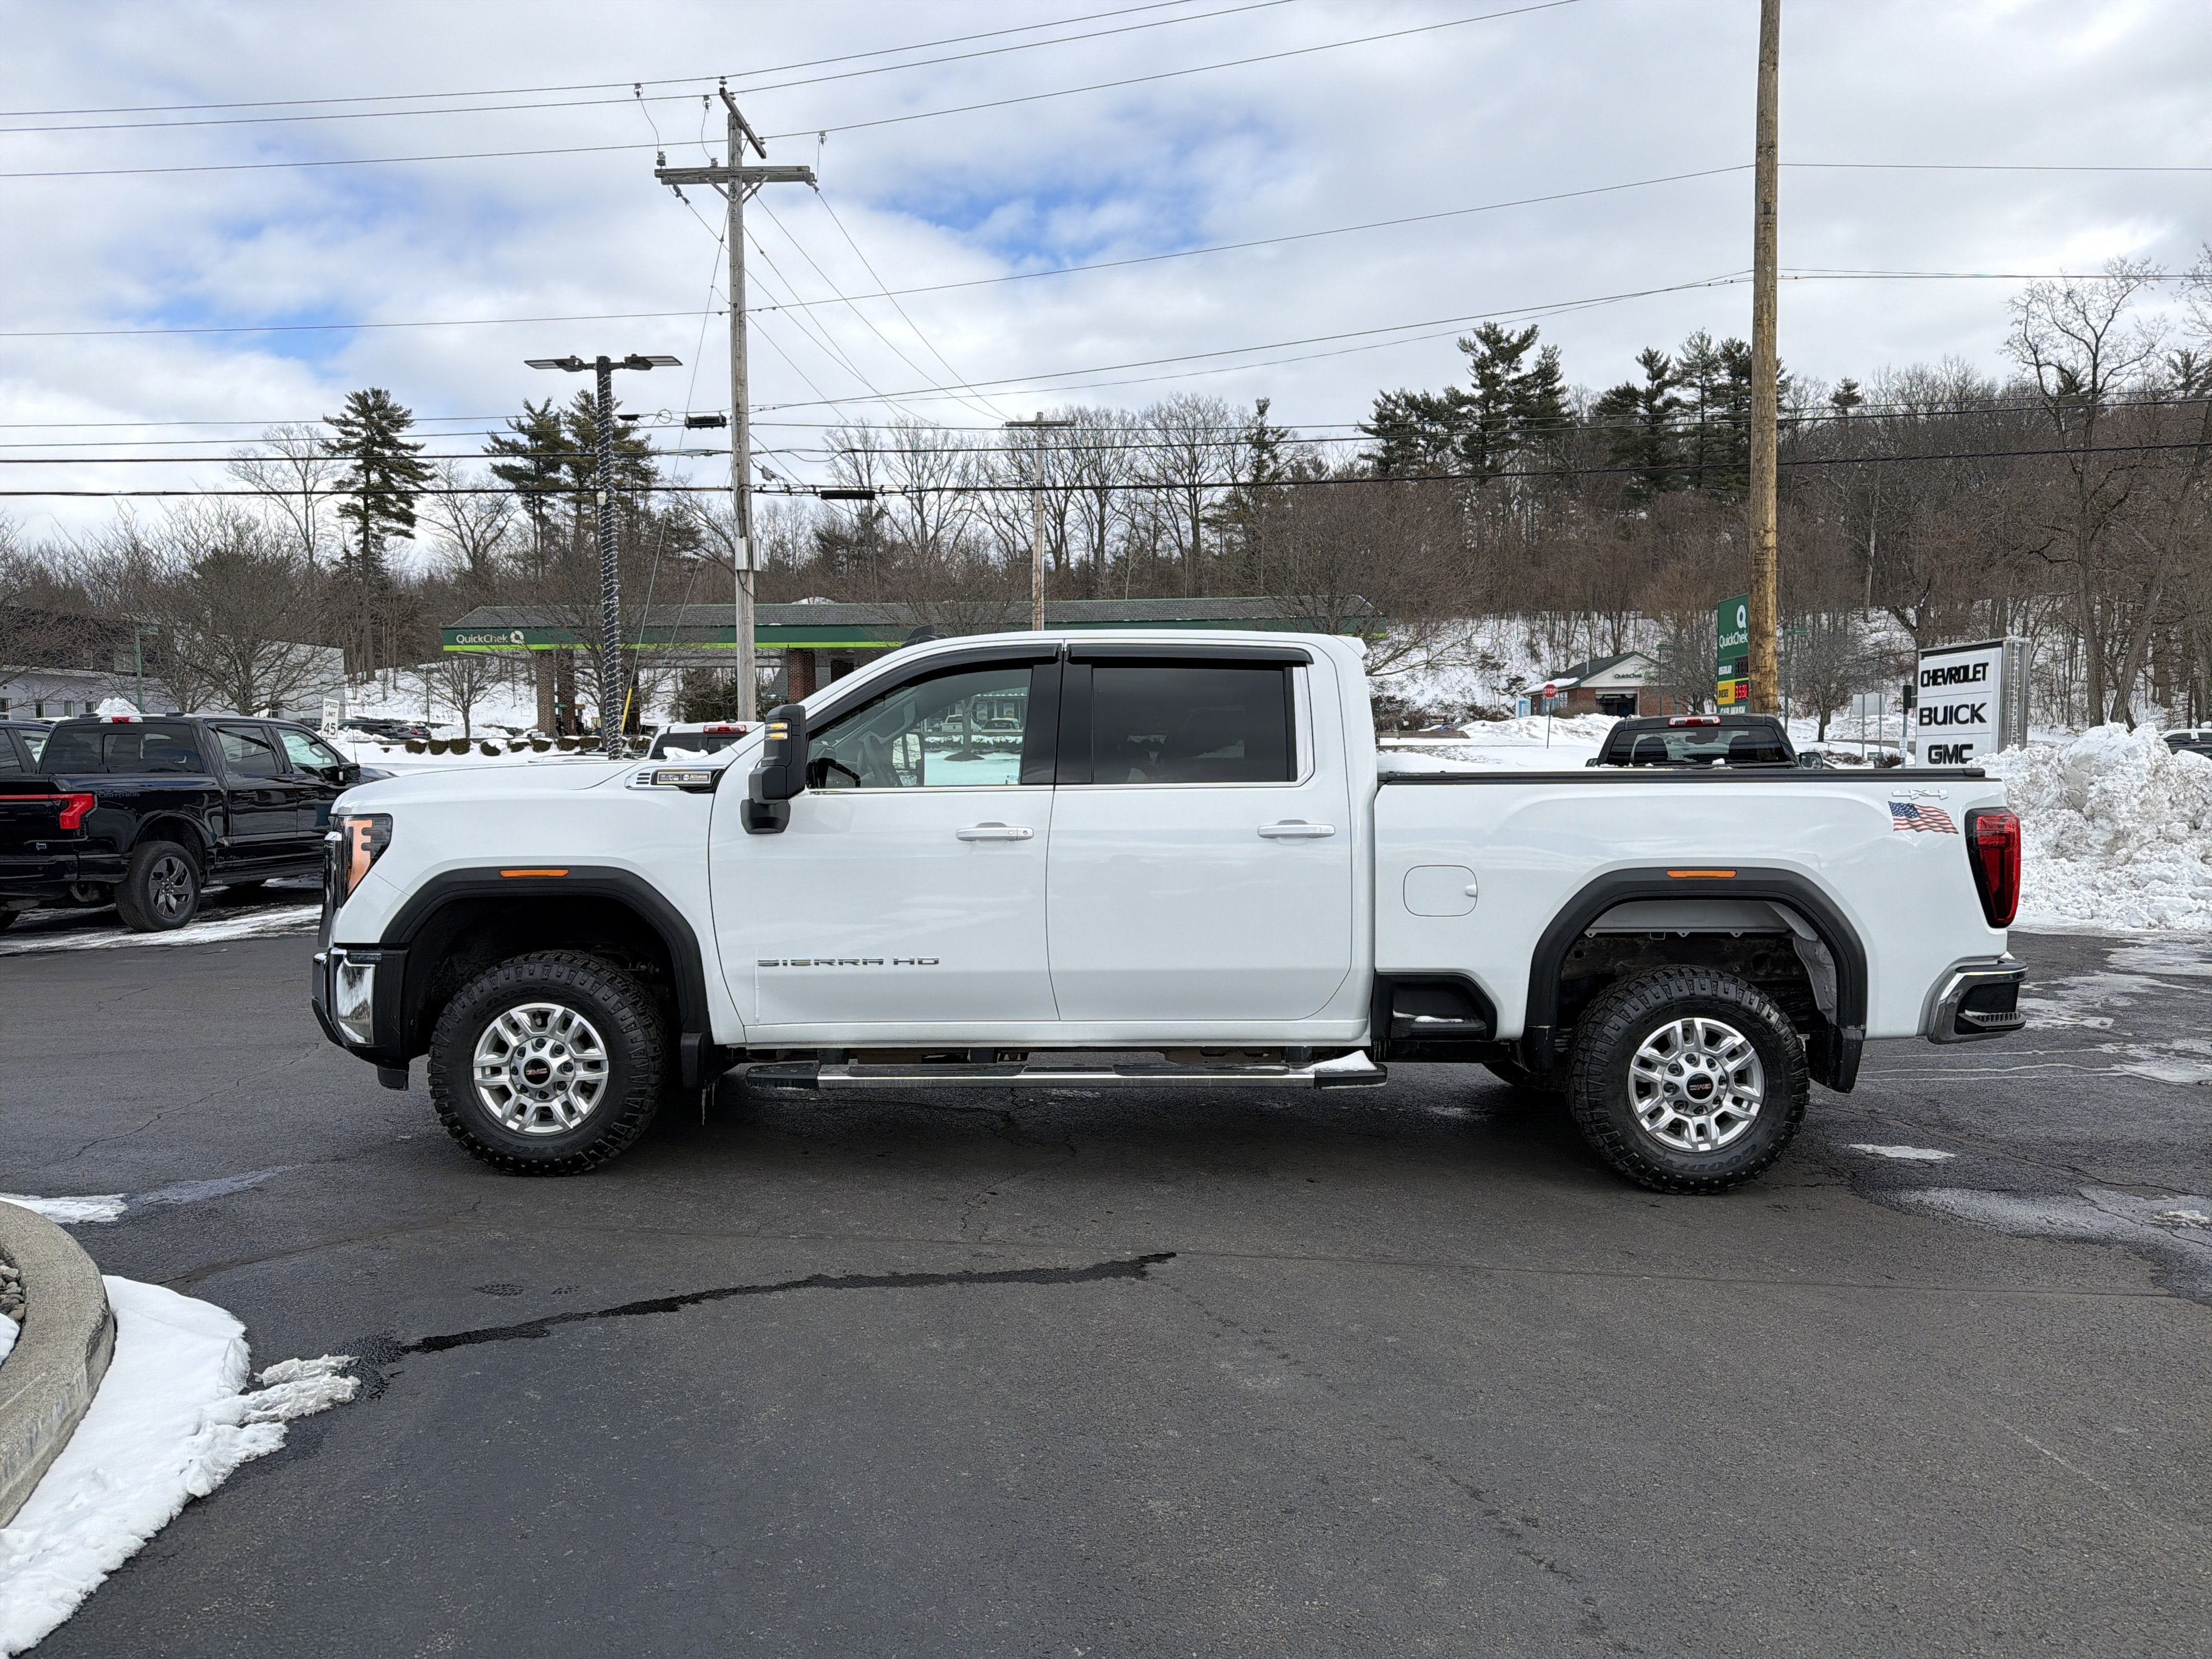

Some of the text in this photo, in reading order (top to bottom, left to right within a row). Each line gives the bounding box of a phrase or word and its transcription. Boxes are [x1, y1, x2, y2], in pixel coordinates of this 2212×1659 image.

[456, 634, 508, 644] QuickChek
[1719, 629, 1748, 649] QuickChek
[1920, 662, 1989, 687] CHEVROLET
[1718, 689, 1729, 698] DIESEL
[1919, 702, 1987, 726] BUICK
[323, 722, 336, 735] 45
[1928, 743, 1973, 764] GMC
[758, 957, 940, 966] SIERRA HD
